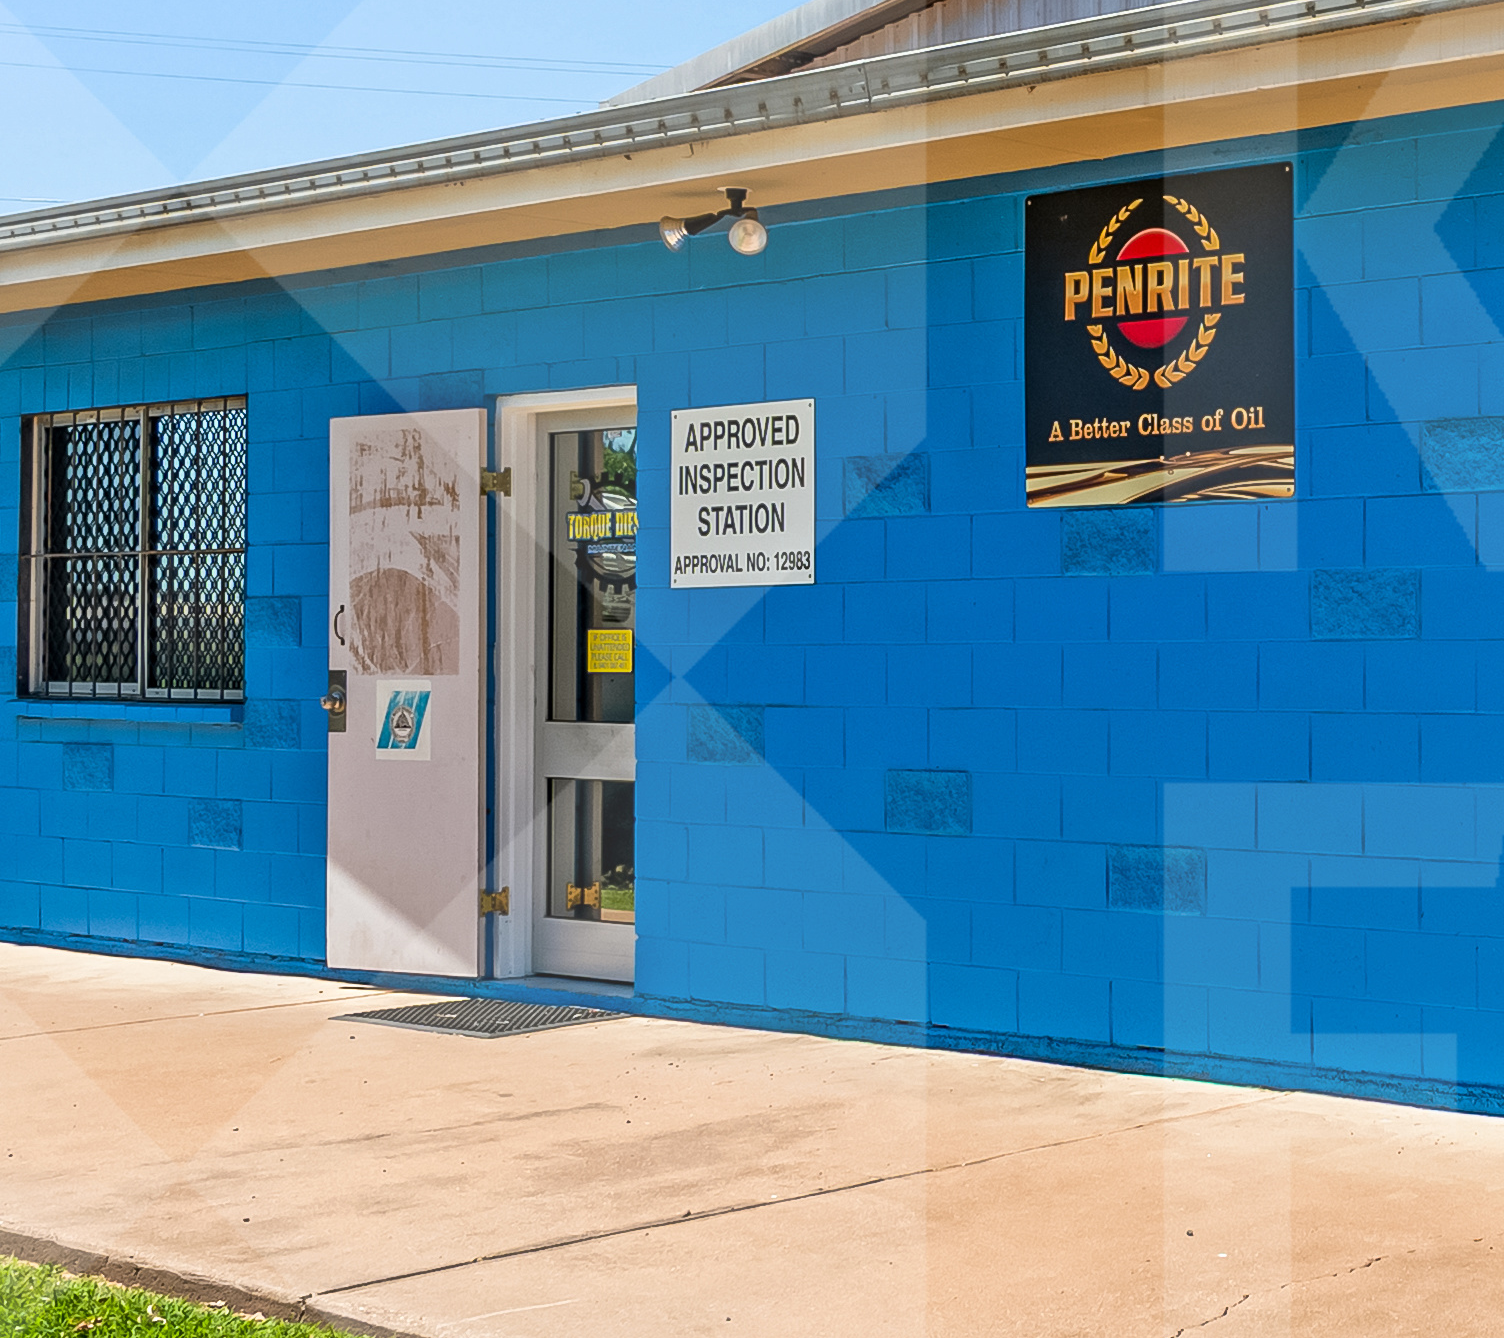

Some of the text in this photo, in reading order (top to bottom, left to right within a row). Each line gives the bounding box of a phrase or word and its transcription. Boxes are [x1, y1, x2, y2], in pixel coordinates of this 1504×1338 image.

[1064, 252, 1245, 321] PENRITE
[684, 414, 800, 453] APPROVED
[1048, 406, 1265, 442] A Better Class of Oil
[678, 457, 805, 495] INSPECTION
[567, 512, 612, 541] TORQUE
[697, 502, 785, 537] STATION
[674, 550, 811, 575] APPROVAL NO: 12983
